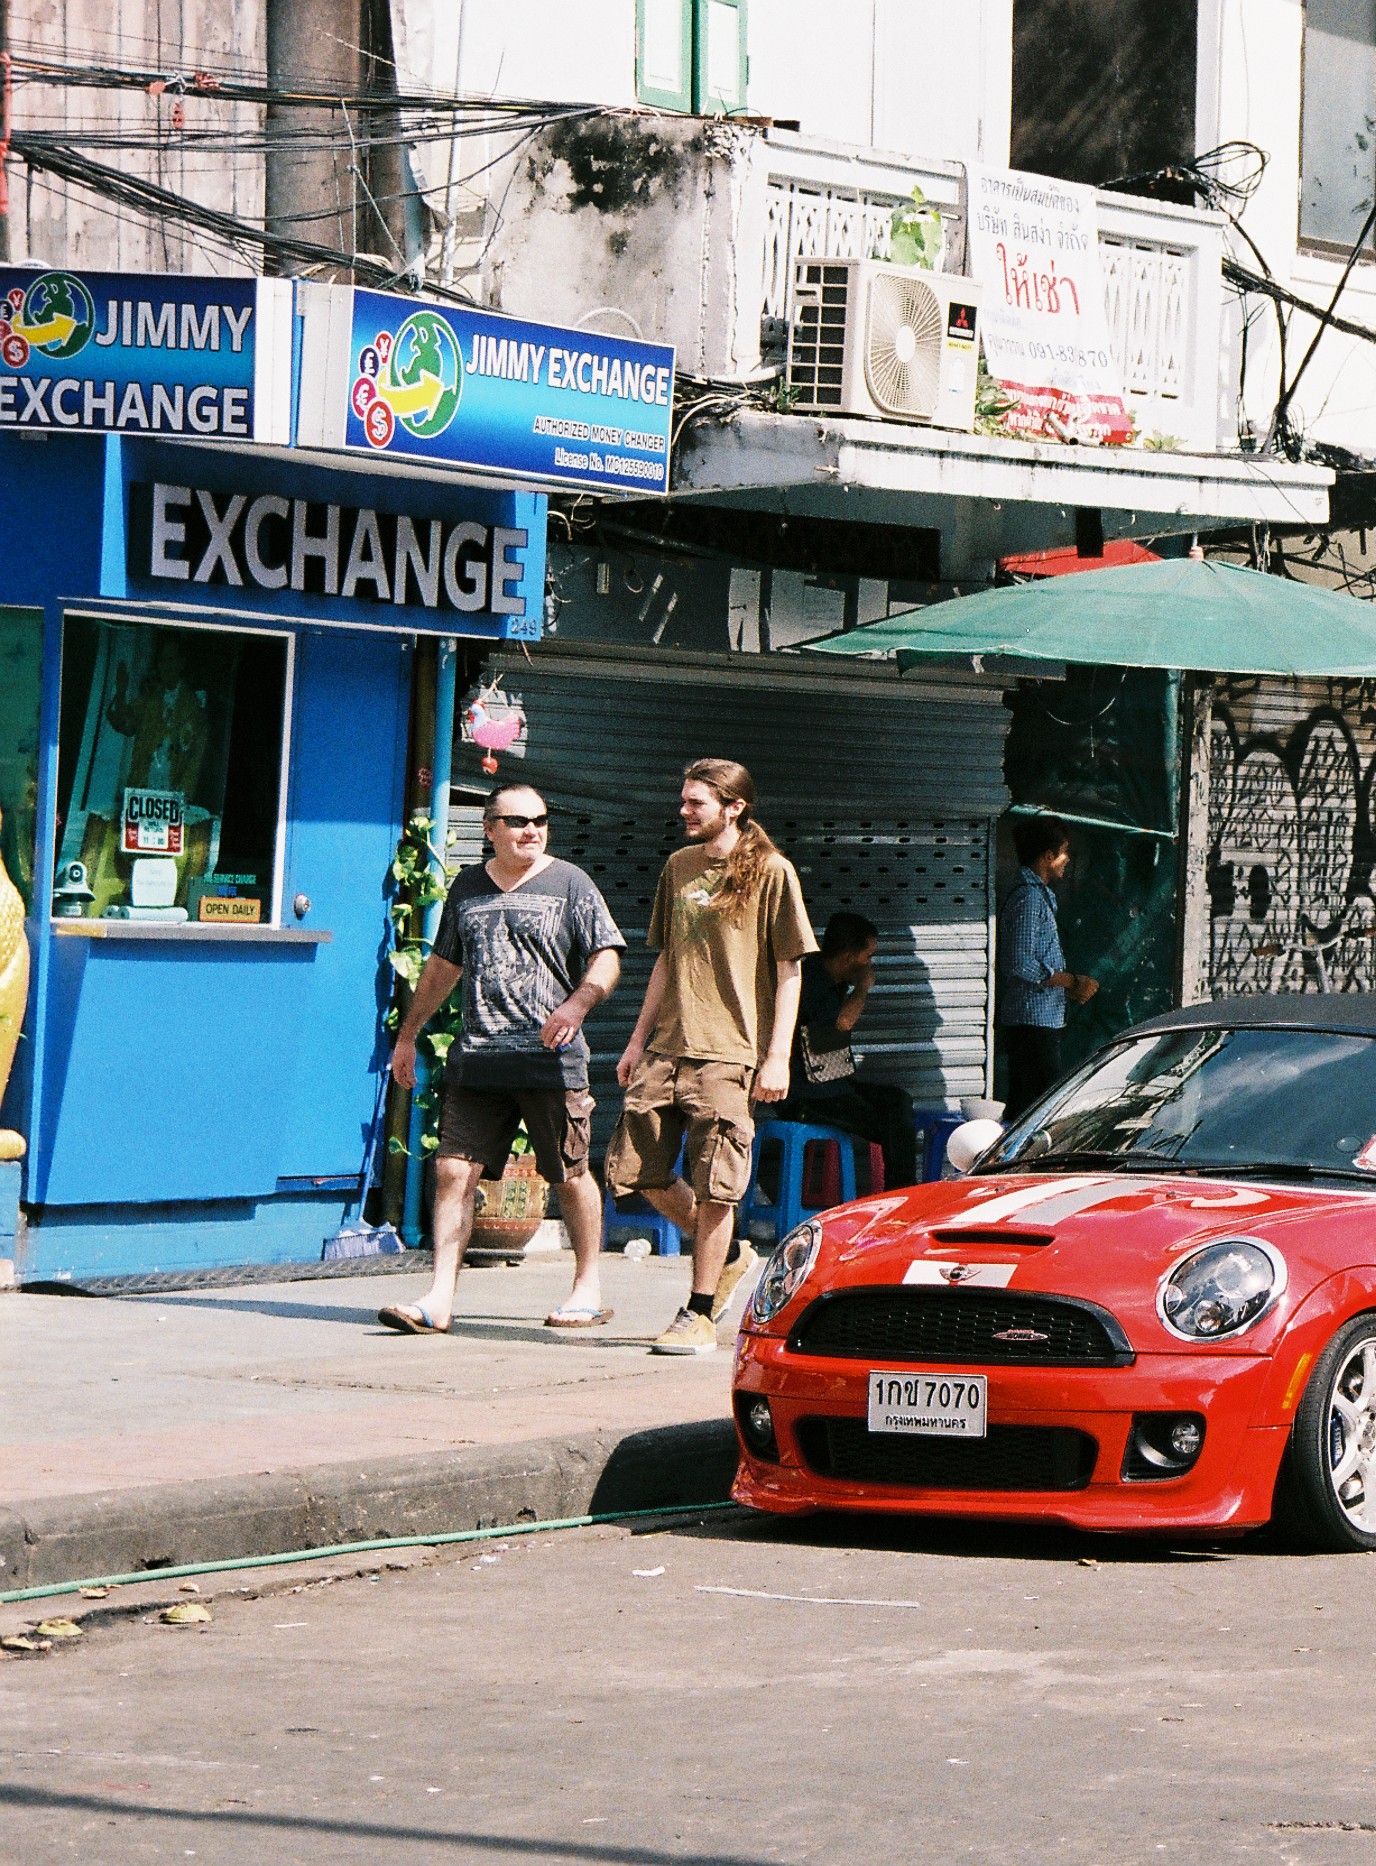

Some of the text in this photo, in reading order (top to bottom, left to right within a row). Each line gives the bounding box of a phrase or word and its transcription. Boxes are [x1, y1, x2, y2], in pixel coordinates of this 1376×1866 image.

[996, 242, 1079, 315] ให้เช่า
[95, 300, 253, 352] JIMMY
[465, 333, 670, 406] JIMMY EXCHANGE
[0, 376, 249, 434] EXCHANGE
[533, 416, 666, 453] AUTHORIZED MONEY CHANGER
[554, 448, 588, 468] License
[589, 453, 604, 471] No.
[150, 482, 529, 616] EXCHANGE
[129, 796, 180, 823] CLOSED
[205, 903, 256, 916] OPEN DAILY
[924, 1382, 981, 1410] 7070
[884, 1414, 967, 1430] กรุงเทพมหานคร
